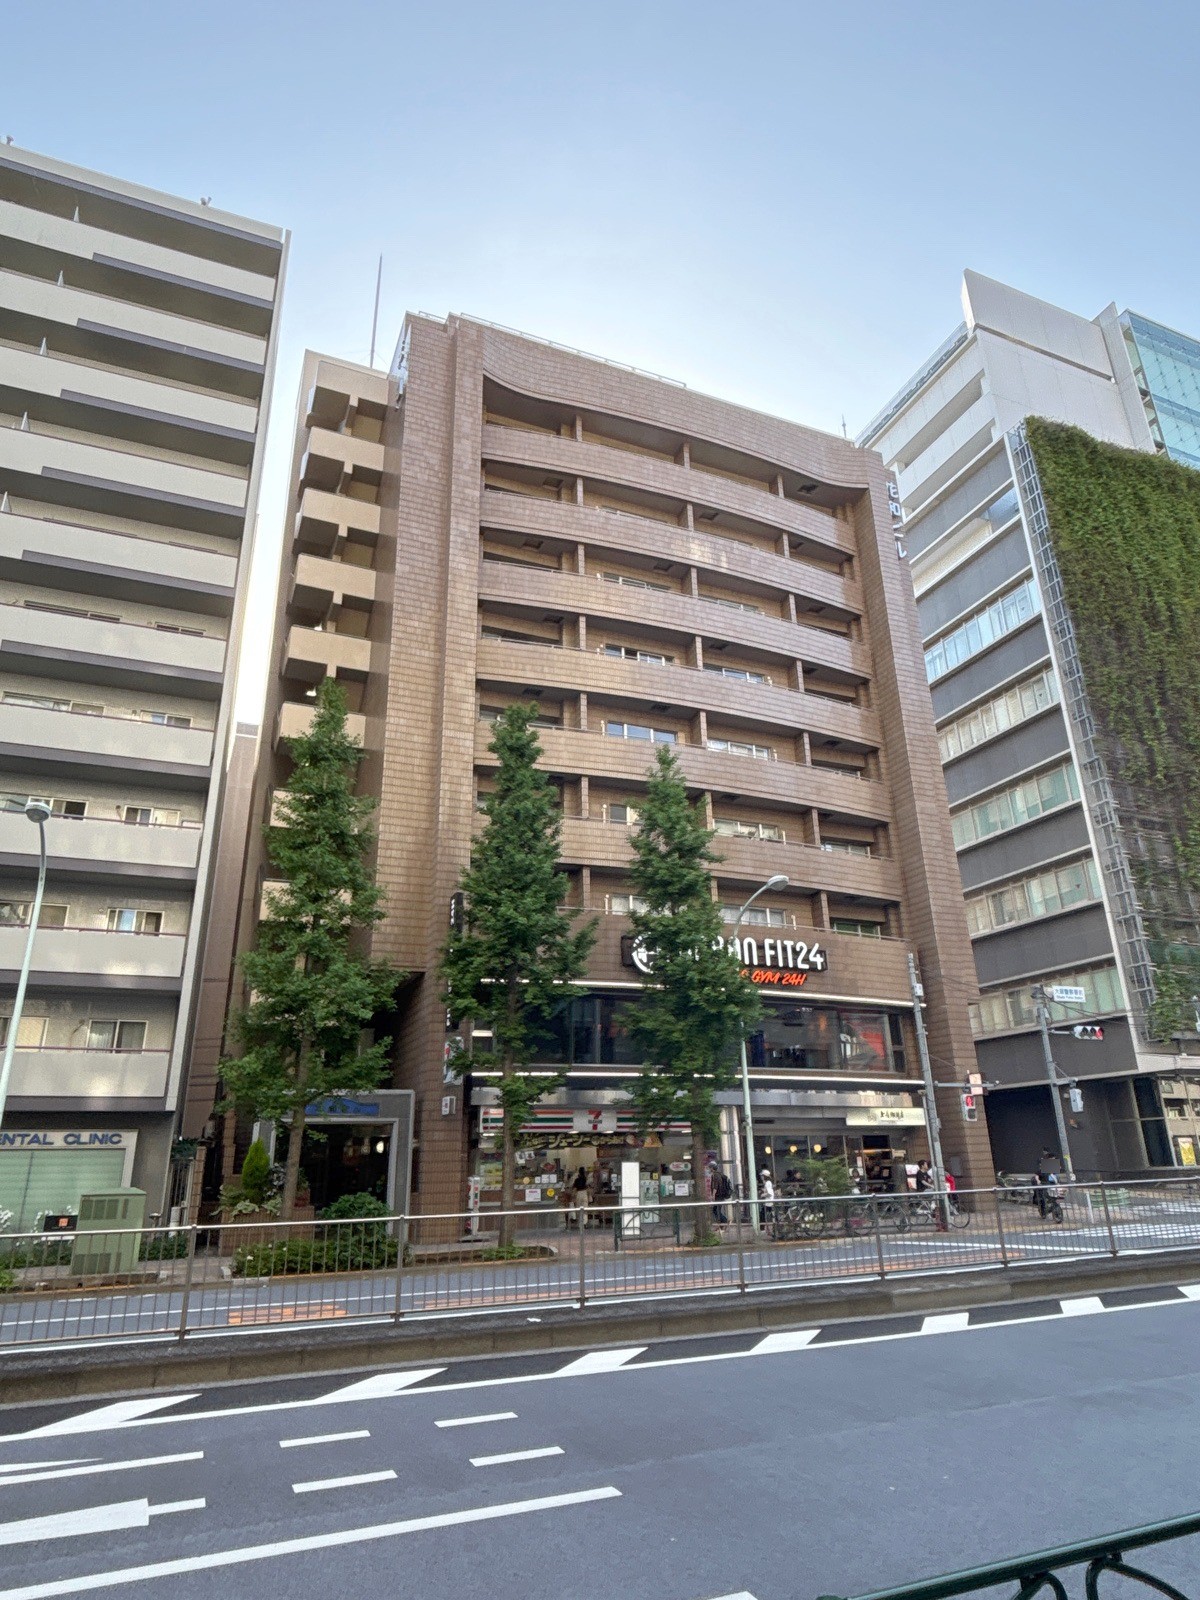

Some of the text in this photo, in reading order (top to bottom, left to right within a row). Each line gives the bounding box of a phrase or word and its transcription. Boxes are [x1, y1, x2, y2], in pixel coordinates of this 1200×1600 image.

[764, 938, 824, 970] FIT24
[751, 970, 781, 985] GYM
[782, 973, 807, 986] 24H
[0, 1133, 123, 1146] NTAL CLINIC
